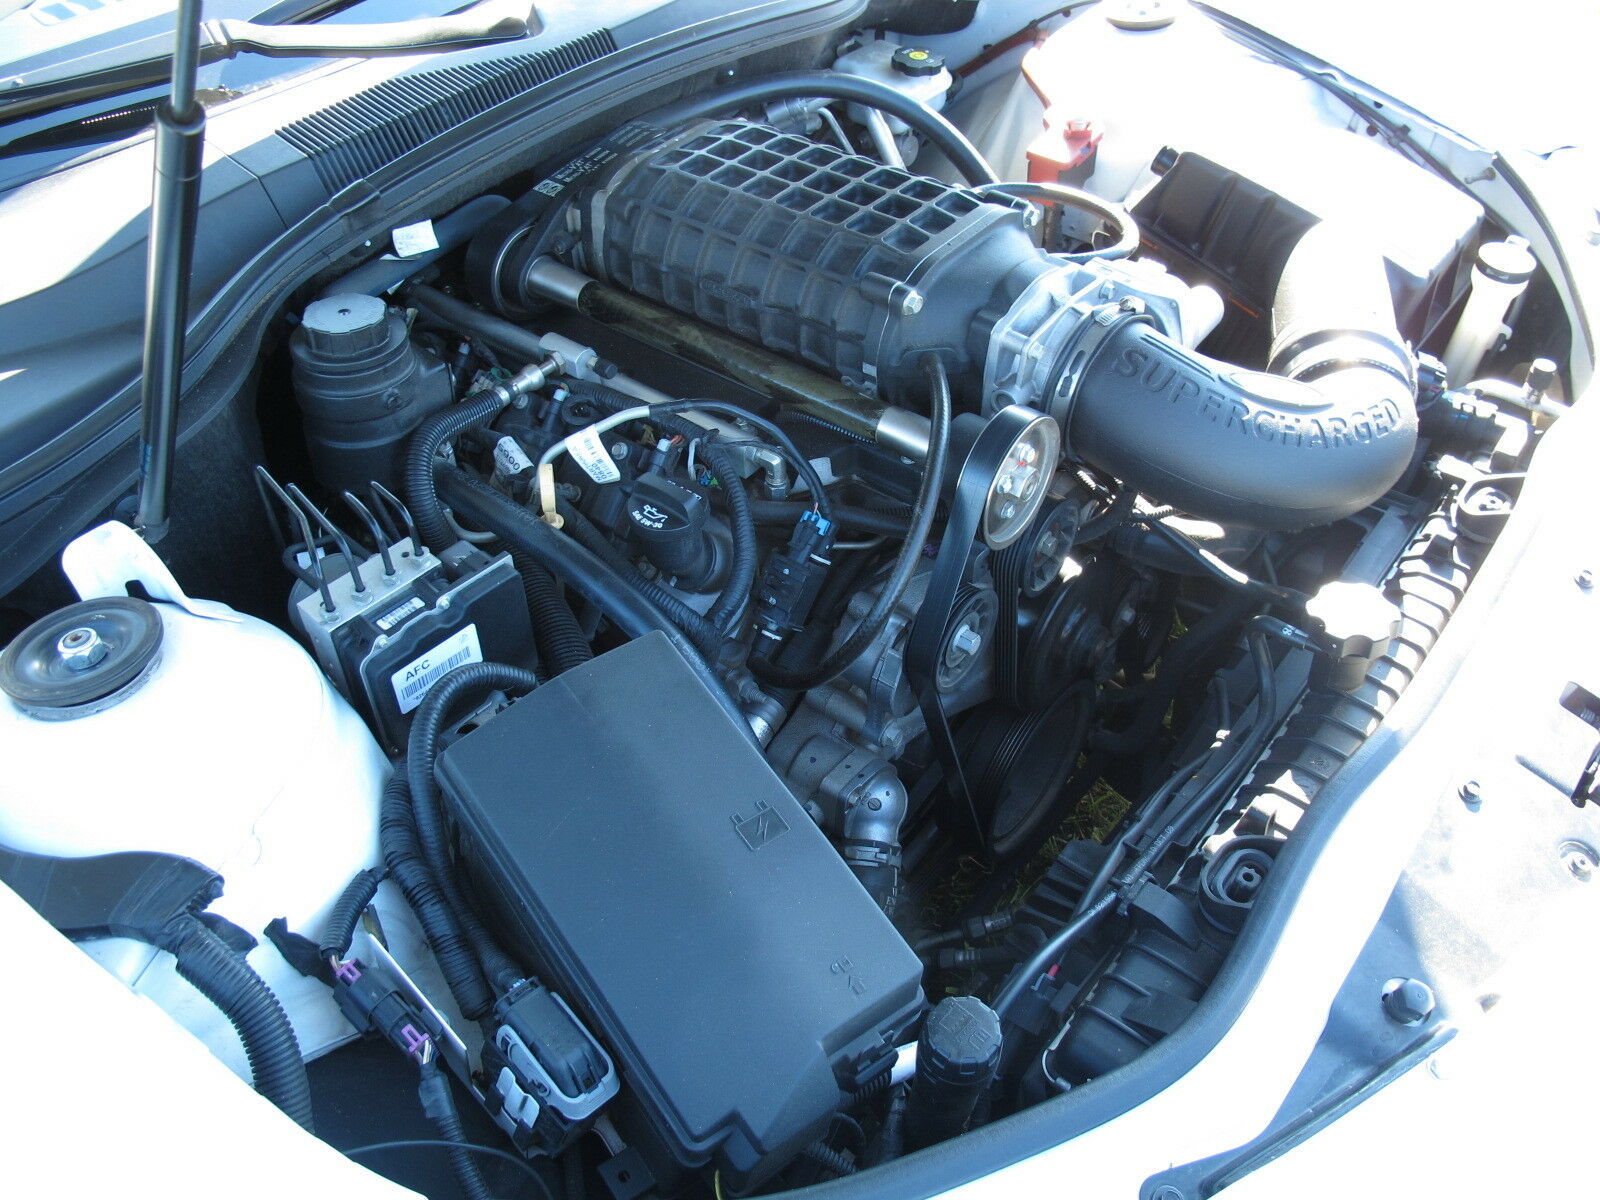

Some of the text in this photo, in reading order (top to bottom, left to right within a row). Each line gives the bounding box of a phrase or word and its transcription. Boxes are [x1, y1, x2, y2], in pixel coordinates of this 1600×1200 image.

[1111, 347, 1401, 449] SUPERCHARGED
[632, 509, 663, 529] SAE 5W-30
[405, 659, 431, 682] AFC
